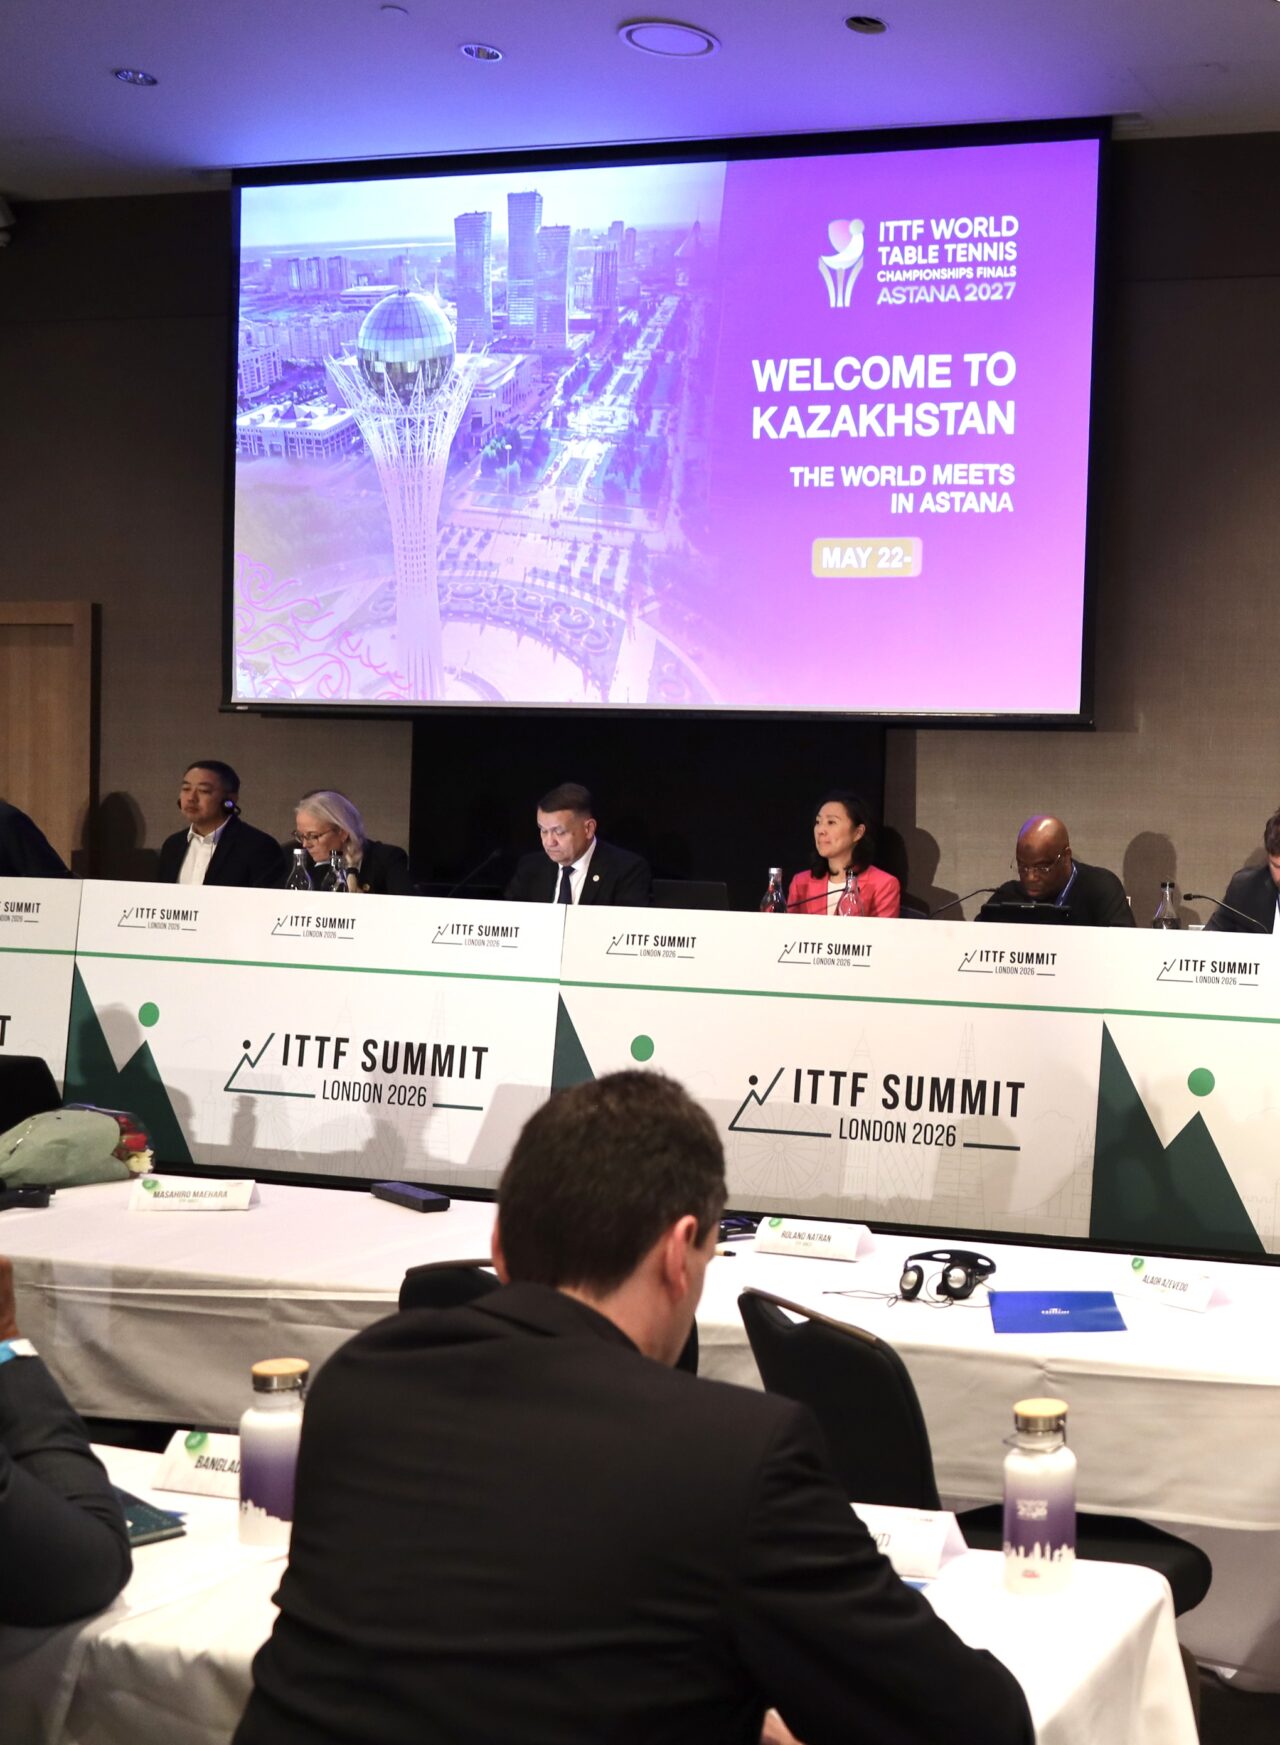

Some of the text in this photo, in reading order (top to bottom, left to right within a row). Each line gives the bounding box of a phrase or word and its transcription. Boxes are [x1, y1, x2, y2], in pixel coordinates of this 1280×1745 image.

[879, 215, 1019, 242] ITTF WORLD
[877, 240, 1017, 266] TABLE TENNIS
[876, 265, 1017, 282] CHAMPIONSHIPS FINALS
[876, 281, 1017, 305] ASTANA 2027
[751, 351, 1016, 392] WELCOME TO
[752, 400, 1015, 439] KAZAKHSTAN
[789, 463, 1015, 487] THE WORLD MEETS
[890, 491, 1014, 513] IN ASTANA
[821, 546, 873, 569] MAY
[3, 901, 41, 913] SUMMIT
[135, 907, 200, 922] ITTF SUMMIT
[147, 922, 167, 930] LONDON
[290, 915, 356, 930] ITTF SUMMIT
[451, 923, 520, 938] ITTF SUMMIT
[302, 930, 323, 938] LONDON
[464, 938, 486, 946] LONDON
[626, 933, 697, 949] ITTF SUMMIT
[639, 948, 676, 958] LONDON 2026
[798, 941, 873, 957] ITTF SUMMIT
[812, 957, 851, 967] LONDON 2026
[979, 950, 1057, 966] ITTF SUMMIT
[994, 965, 1035, 976] LONDON 2026
[1179, 959, 1261, 975] ITTF SUMMIT
[1195, 975, 1238, 986] LONDON 2026
[281, 1033, 489, 1080] ITTF SUMMIT
[322, 1080, 428, 1108] LONDON 2026
[793, 1068, 1025, 1118] ITTF SUMMIT
[839, 1117, 957, 1147] LONDON 2026
[153, 1190, 191, 1198] MASAHIRO
[194, 1455, 240, 1474] BANGLAD
